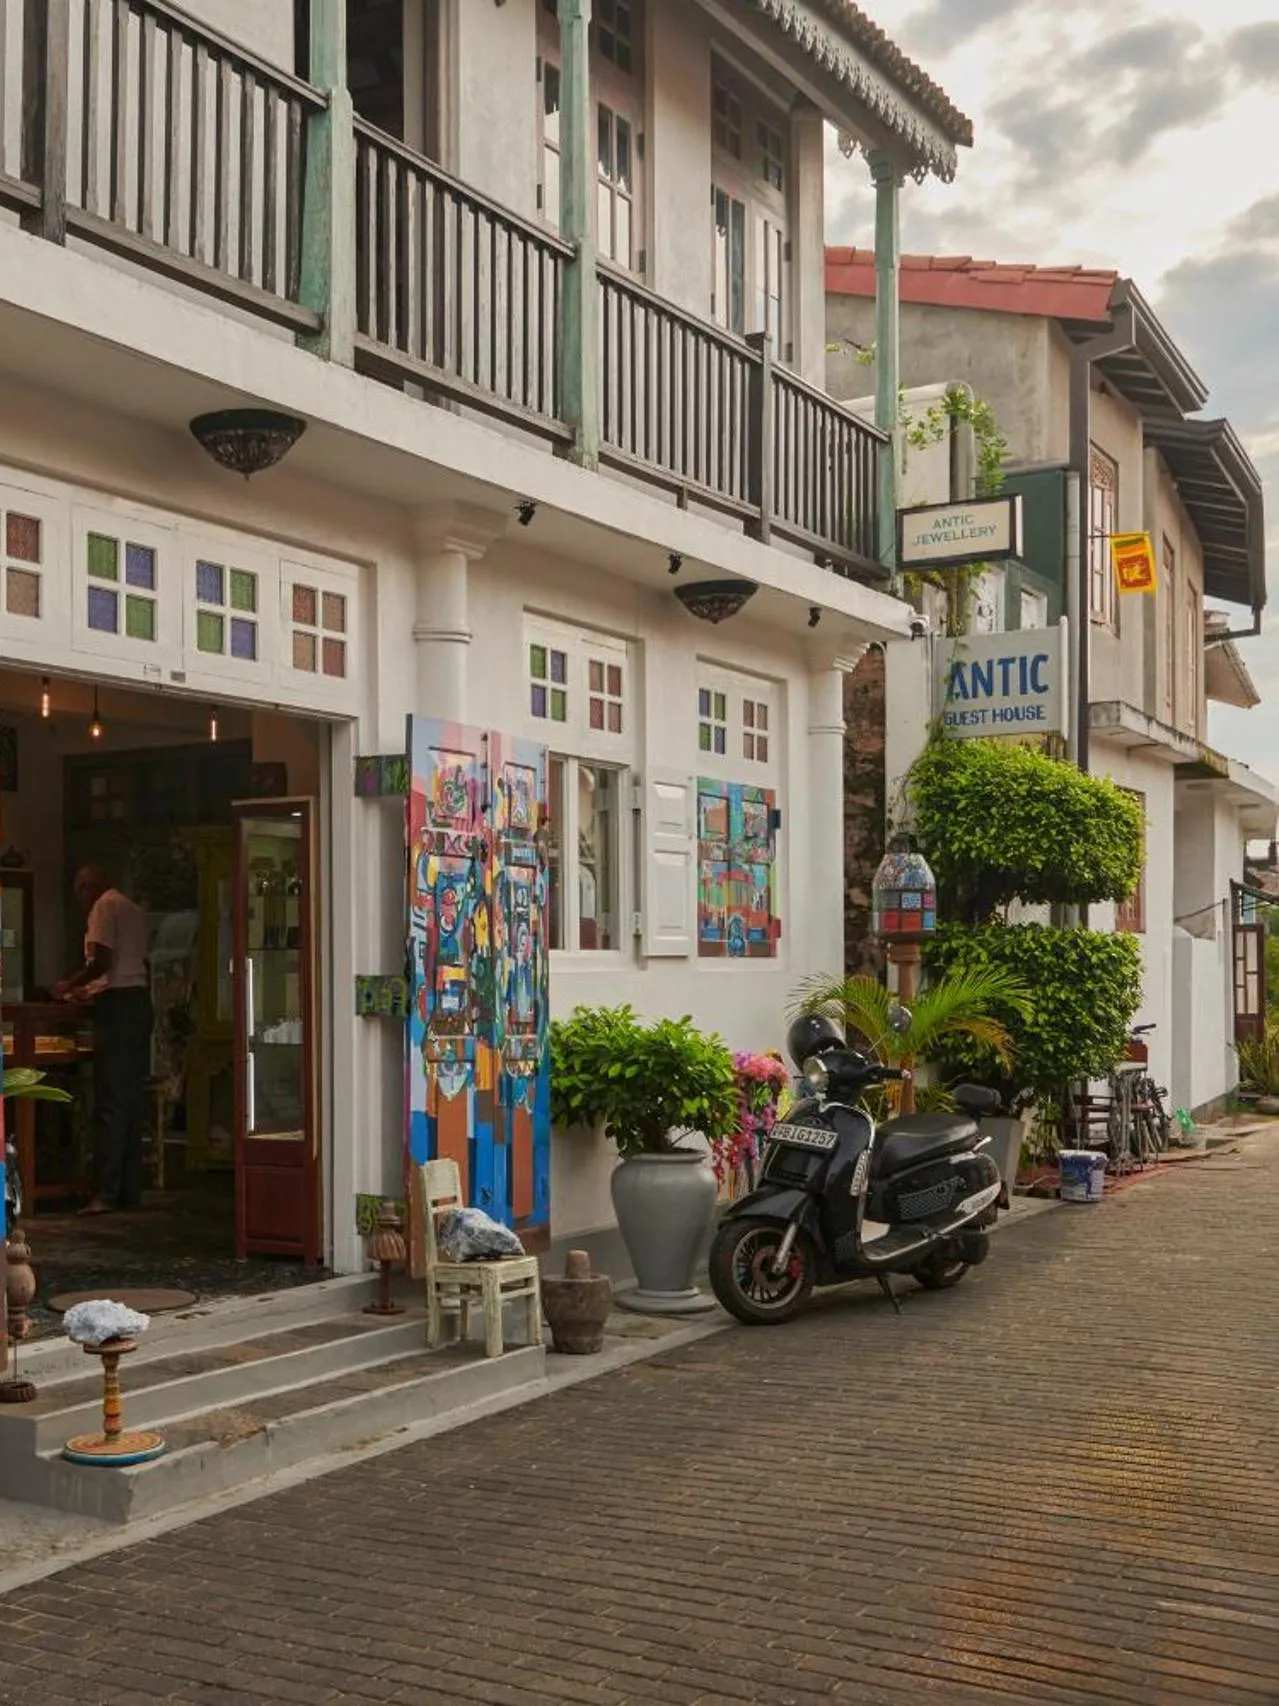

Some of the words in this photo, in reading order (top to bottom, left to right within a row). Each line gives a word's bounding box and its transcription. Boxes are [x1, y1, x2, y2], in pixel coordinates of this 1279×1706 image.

[931, 514, 975, 530] ANTIC
[911, 524, 997, 546] JEWELLERY
[946, 654, 1049, 700] ANTIC
[943, 708, 989, 726] GUEST
[991, 704, 1047, 723] HOUSE
